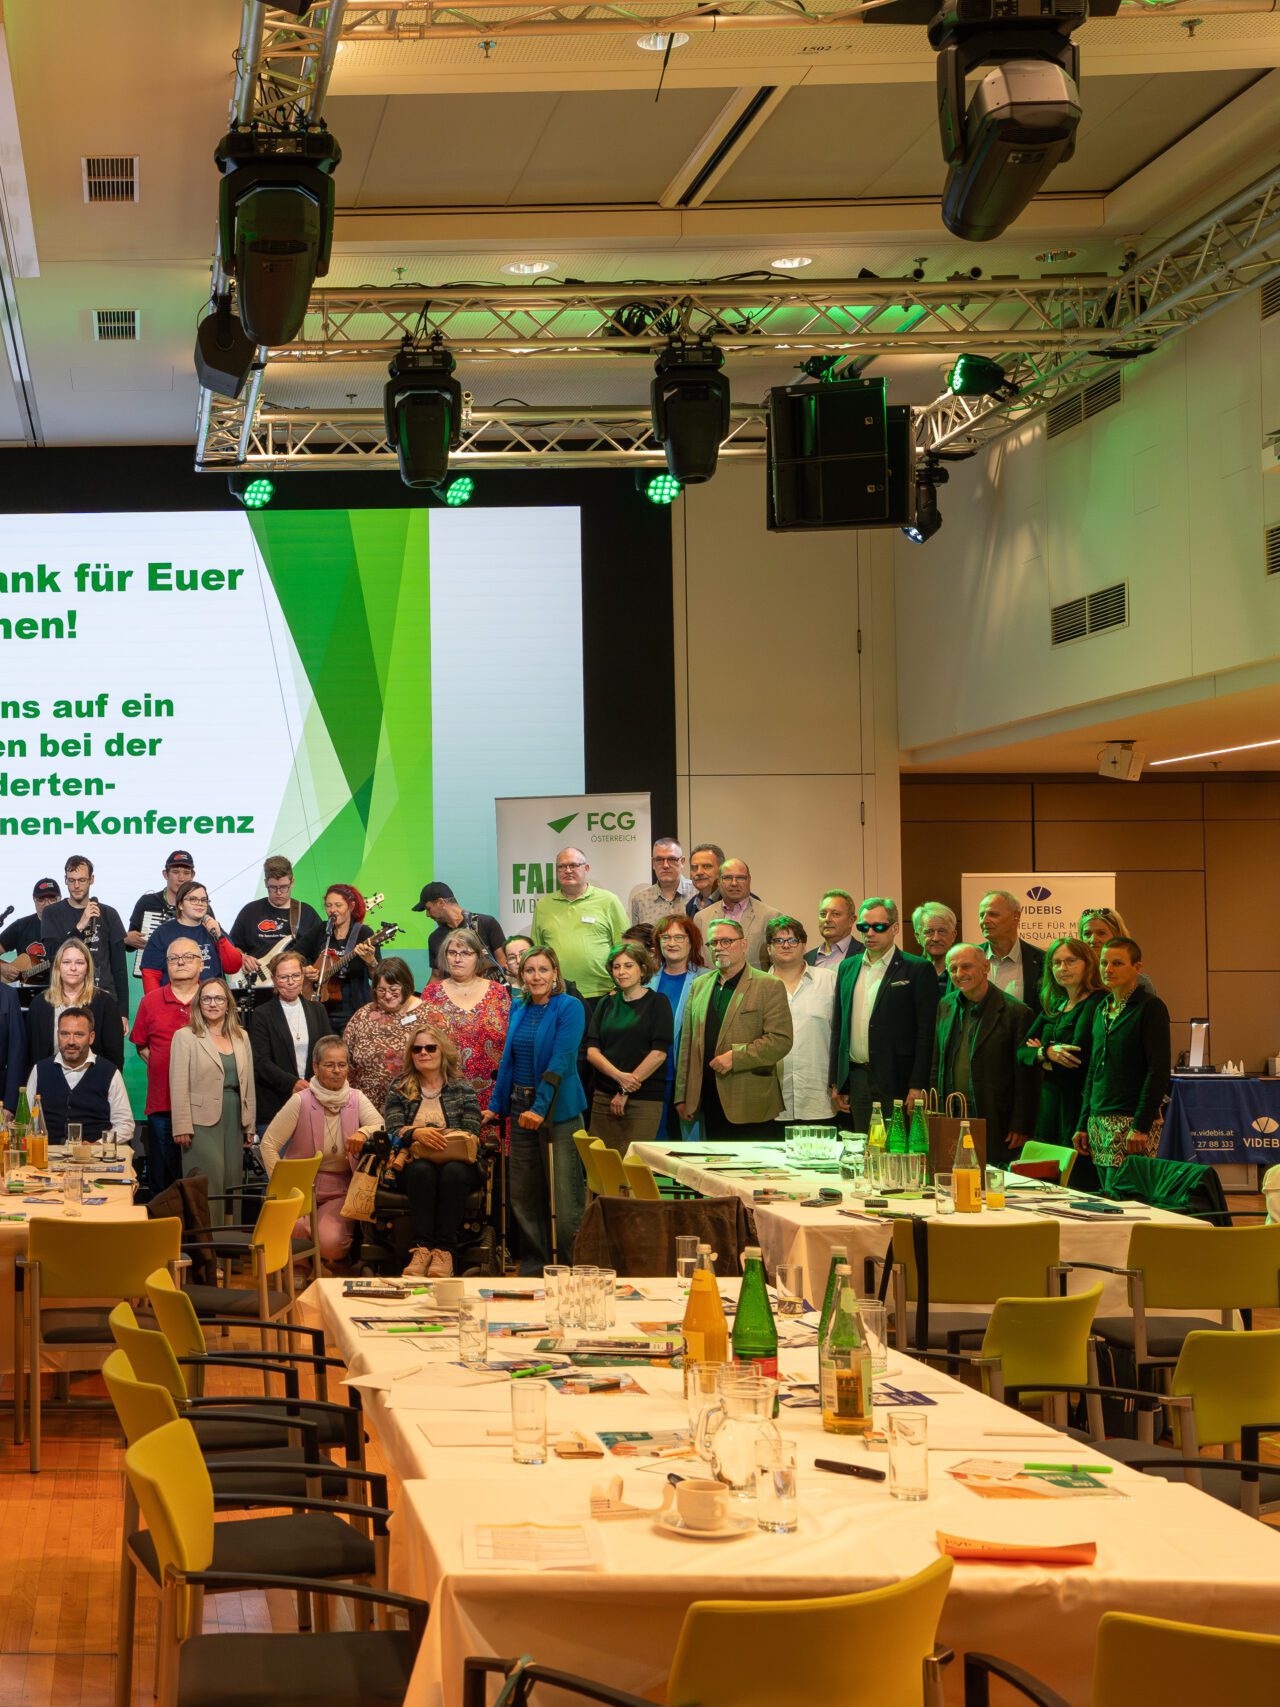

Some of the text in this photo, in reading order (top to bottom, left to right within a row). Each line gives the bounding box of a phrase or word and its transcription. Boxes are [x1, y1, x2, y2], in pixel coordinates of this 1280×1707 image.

[75, 563, 133, 593] für
[148, 563, 244, 591] Euer
[53, 694, 108, 719] auf
[122, 694, 174, 717] ein
[41, 733, 92, 757] bei
[105, 733, 162, 757] der
[587, 812, 636, 831] FCG
[590, 833, 636, 843] ÖSTERREICH
[513, 863, 560, 894] FAI
[513, 898, 526, 914] IM
[1018, 922, 1043, 930] ELFE
[1047, 920, 1065, 930] FÜR
[1019, 931, 1078, 940] NSQUALITÄT
[1190, 1129, 1234, 1137] w.videbis.at
